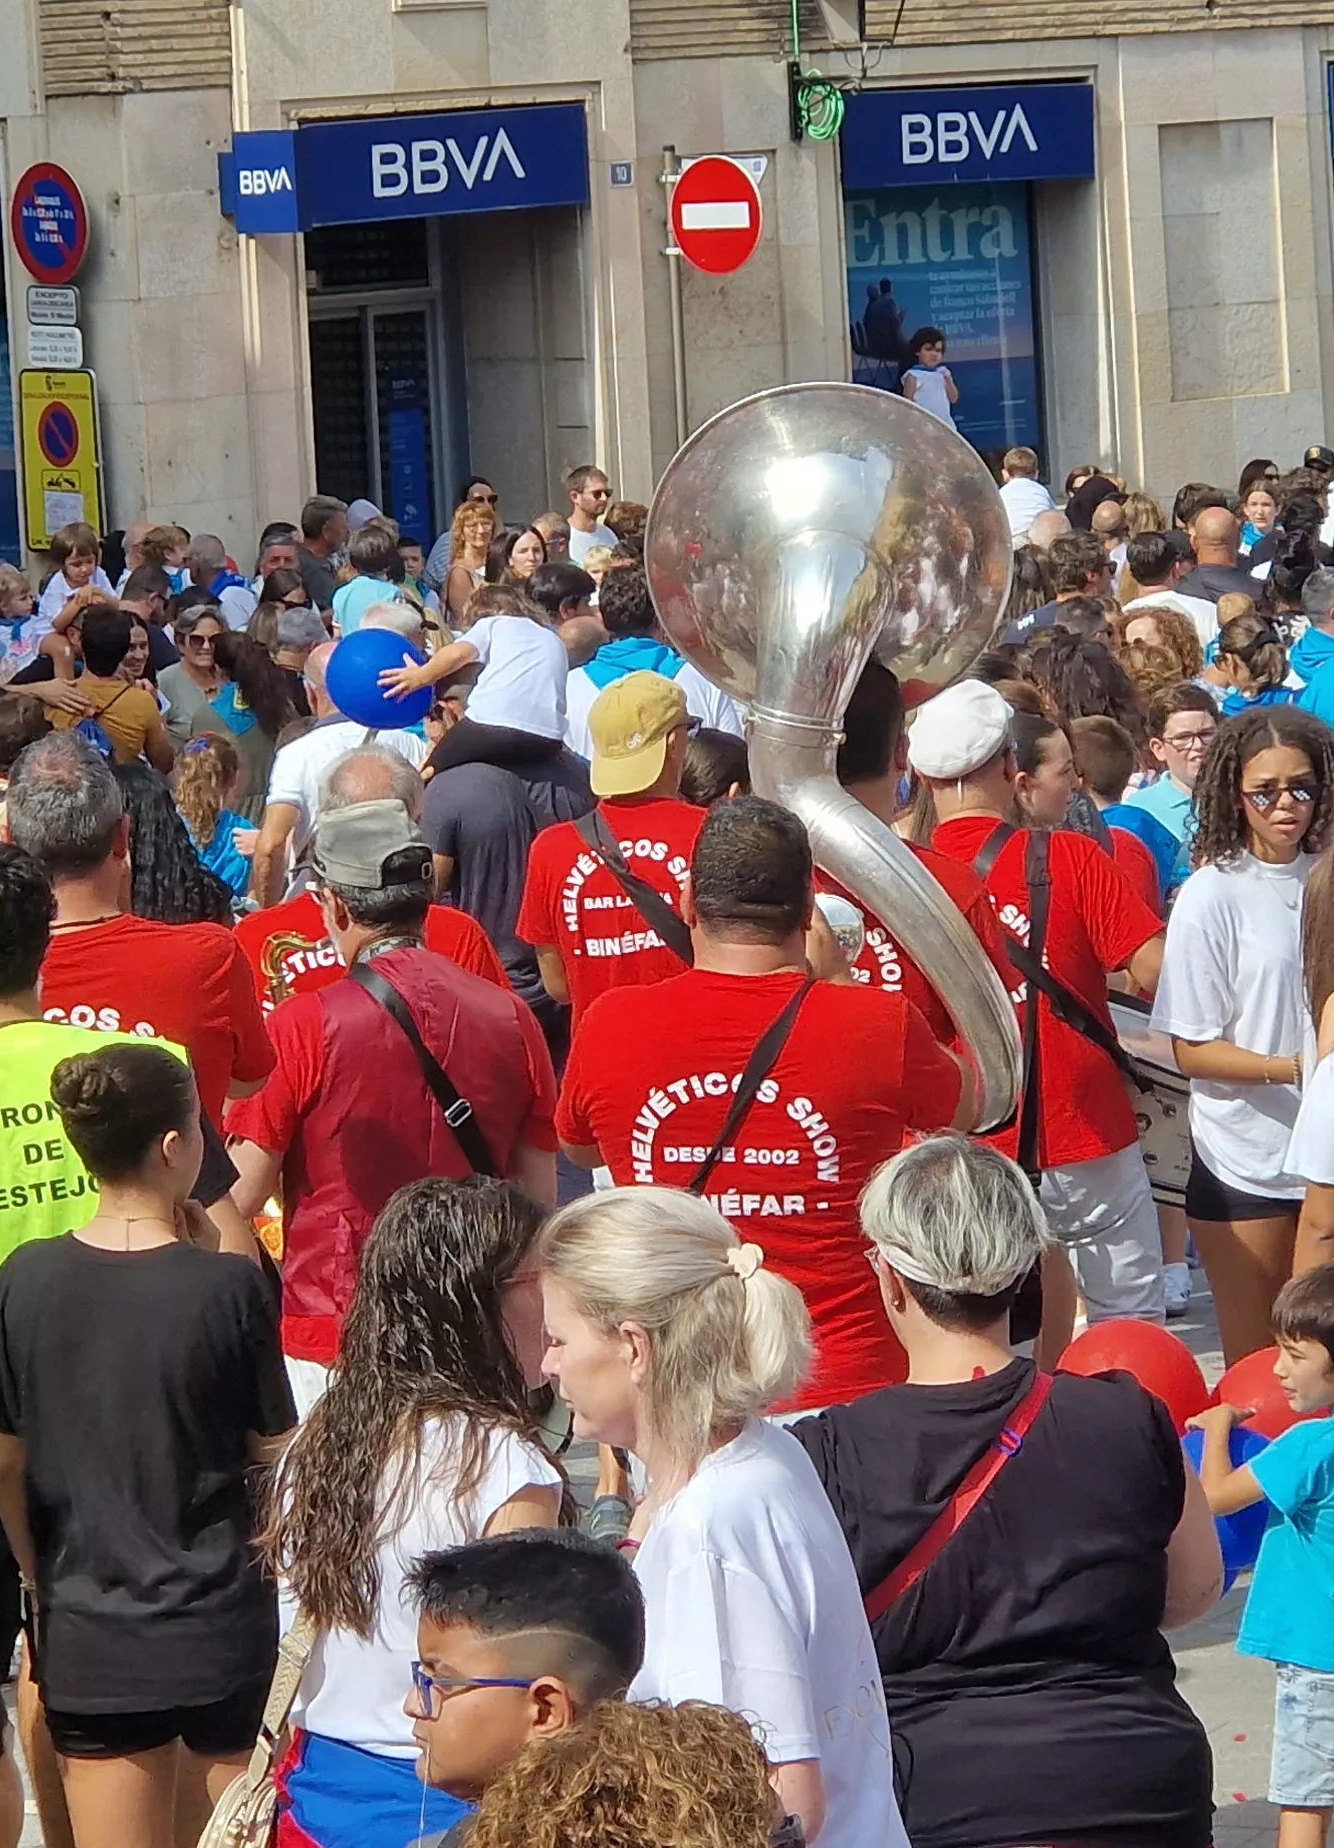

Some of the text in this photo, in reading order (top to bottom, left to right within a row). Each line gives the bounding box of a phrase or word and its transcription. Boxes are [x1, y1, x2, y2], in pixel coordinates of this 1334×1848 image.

[901, 102, 1038, 165] BBVA
[371, 126, 526, 198] BBVA
[616, 165, 628, 181] 10
[239, 165, 293, 195] BBVA
[847, 196, 1018, 267] Entra
[563, 838, 669, 932] HELVÉCOS
[584, 897, 614, 910] BAR
[585, 930, 667, 957] BINÉFA
[23, 1138, 65, 1166] DE
[786, 1096, 840, 1183] SHOW
[743, 1148, 800, 1165] 2002
